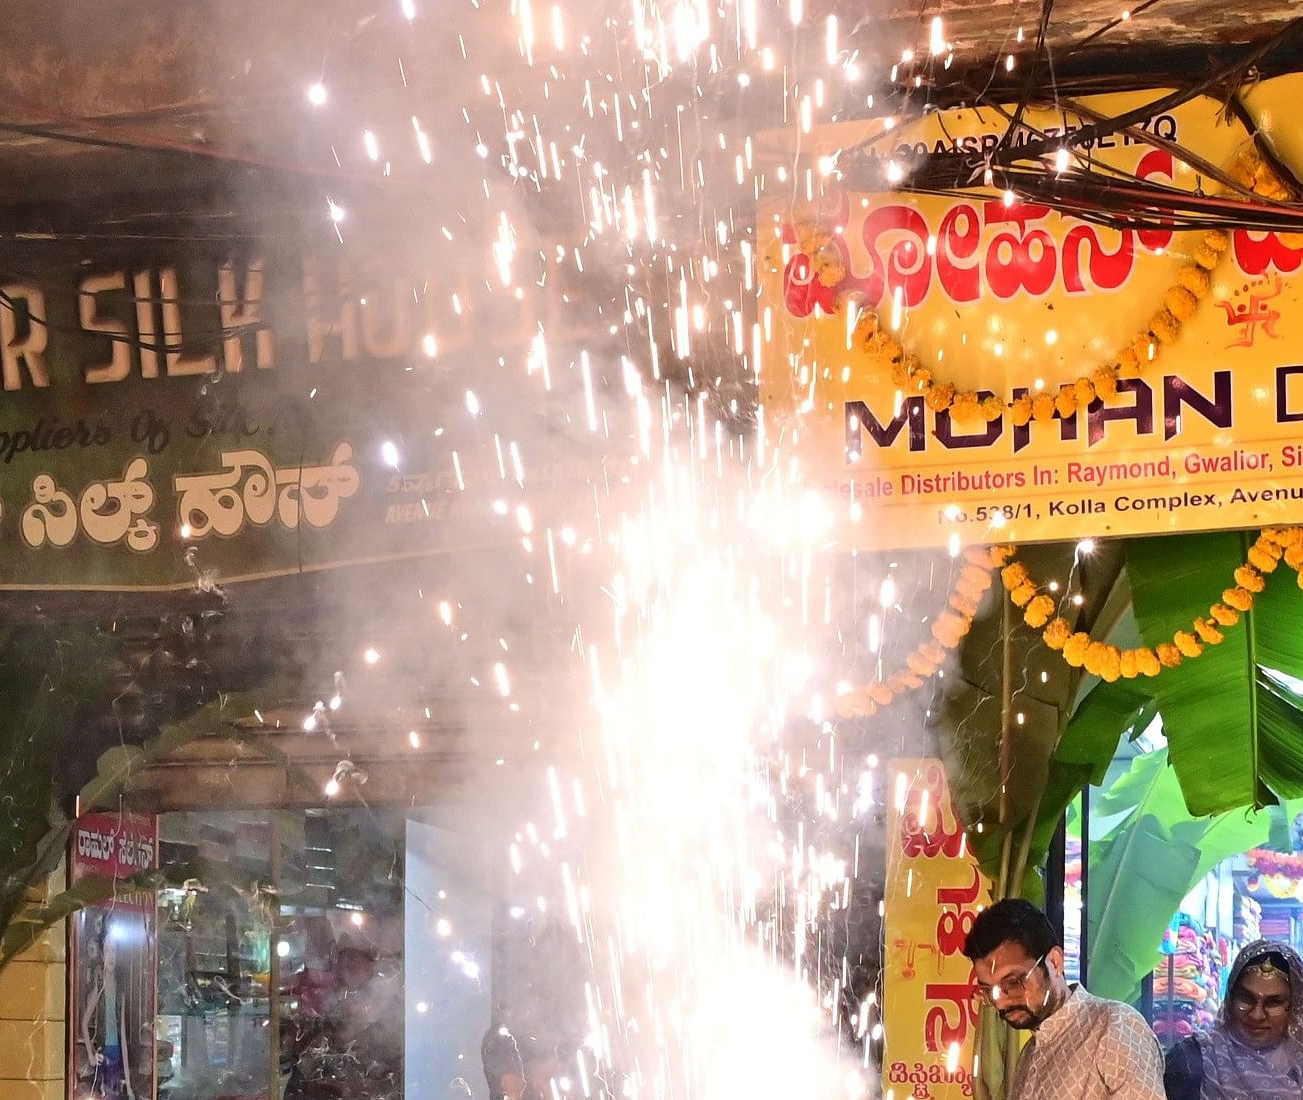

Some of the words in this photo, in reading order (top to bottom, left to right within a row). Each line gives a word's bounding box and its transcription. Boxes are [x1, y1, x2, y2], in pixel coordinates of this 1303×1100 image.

[78, 254, 275, 385] SILK
[844, 370, 1234, 465] MOHAN
[901, 467, 1026, 496] Distributors
[1032, 464, 1060, 485] In:
[1067, 456, 1178, 486] Raymond,
[1183, 448, 1274, 476] Gwalior,
[1048, 498, 1106, 518] Kolla
[1114, 490, 1223, 516] Complex,
